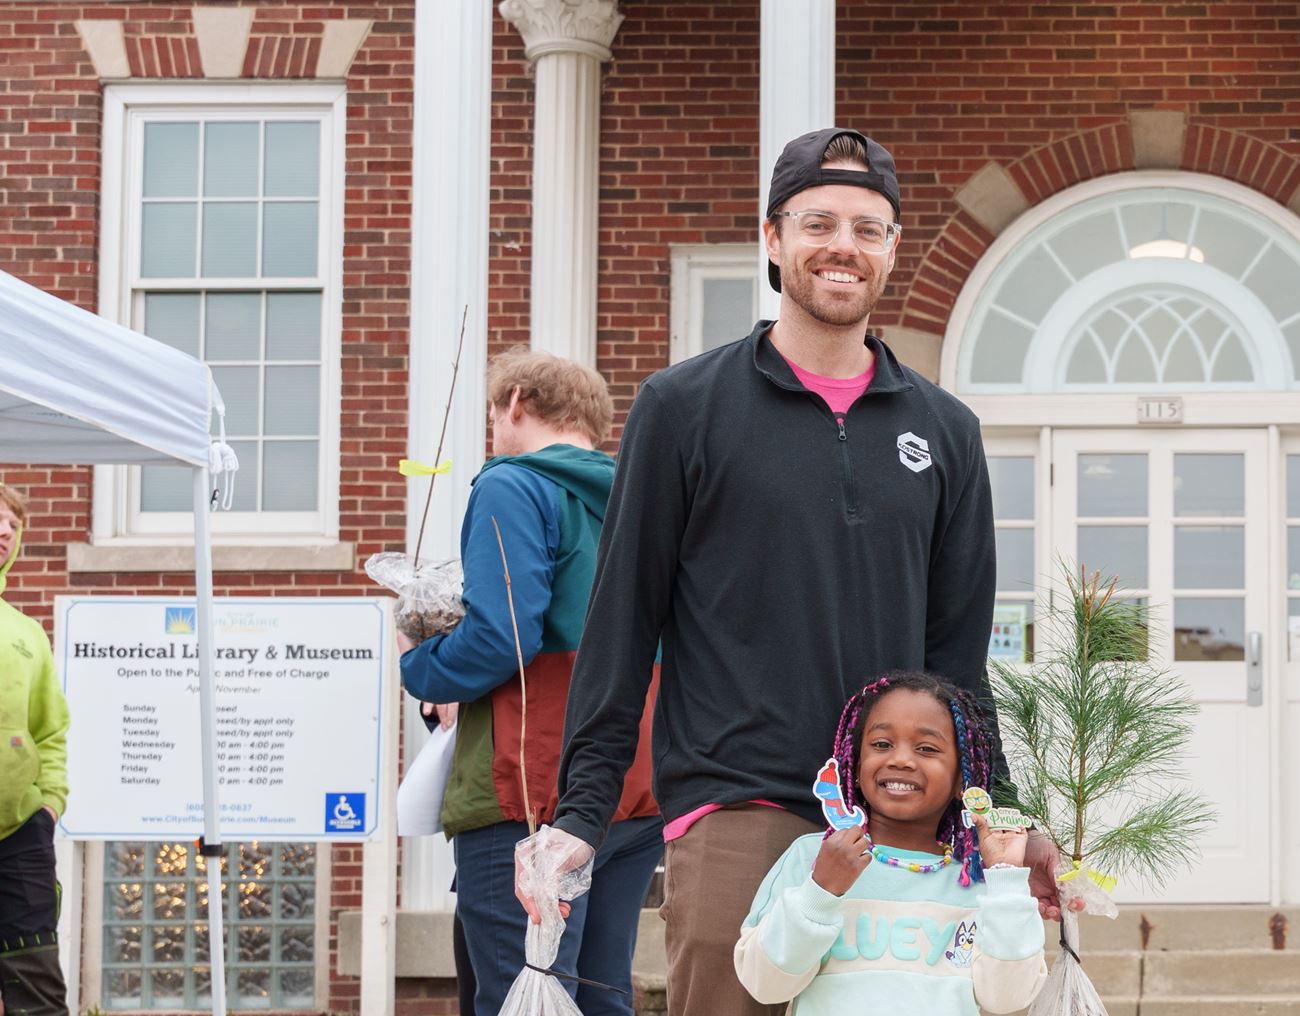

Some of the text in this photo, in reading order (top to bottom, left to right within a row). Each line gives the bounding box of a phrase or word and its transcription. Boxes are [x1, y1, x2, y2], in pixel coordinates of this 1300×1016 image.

[1145, 402, 1177, 418] 115
[74, 642, 373, 664] Historical Lirary & Museum
[117, 667, 330, 680] Open to the Puc and Free of Charge
[215, 685, 262, 694] November
[123, 705, 156, 713] Sunday
[122, 717, 158, 725] Monday
[276, 718, 294, 726] only
[122, 728, 160, 738] Tuesday
[275, 730, 294, 738] only
[122, 741, 175, 749] Wednesday
[122, 752, 162, 761] Thursday
[121, 765, 148, 773] Friday
[249, 765, 268, 773] 4:00
[121, 777, 160, 785] Saturday
[822, 911, 957, 966] LUEY
